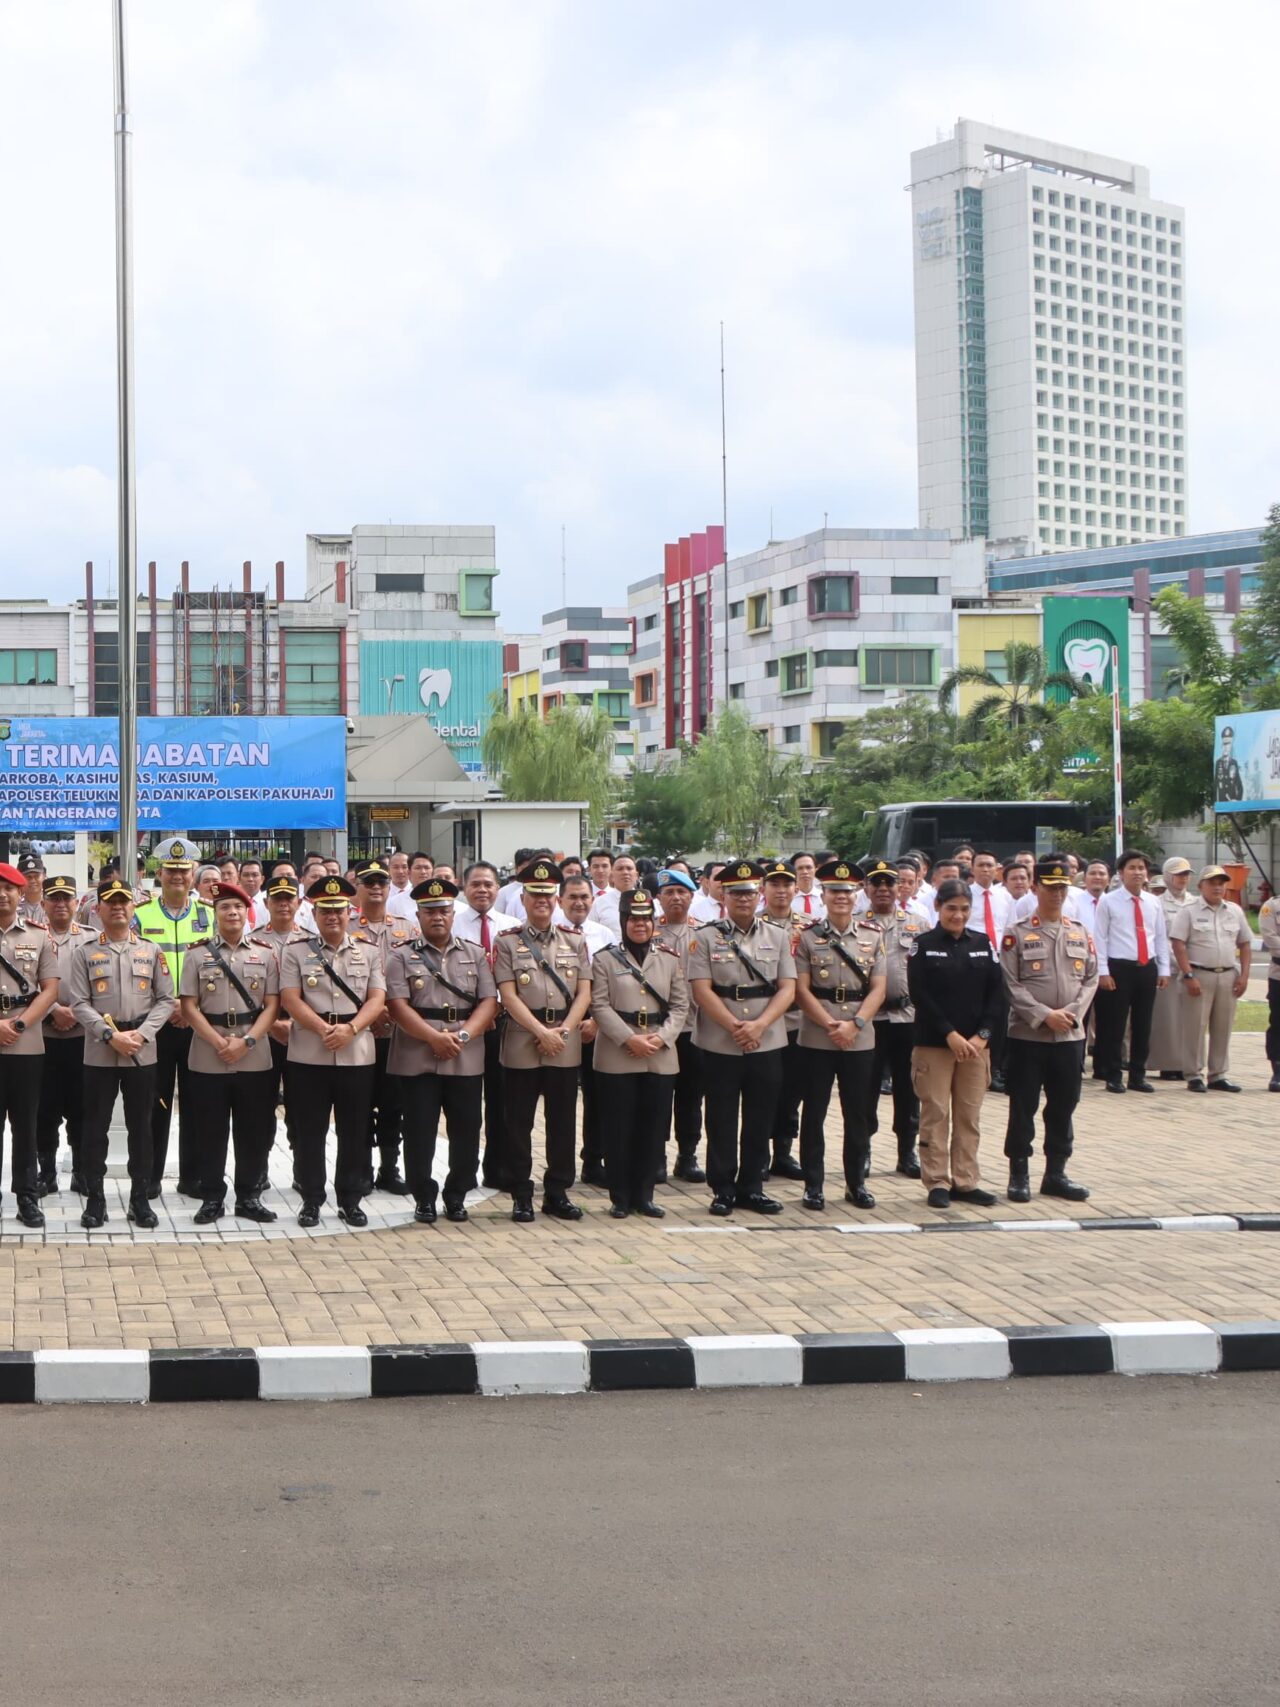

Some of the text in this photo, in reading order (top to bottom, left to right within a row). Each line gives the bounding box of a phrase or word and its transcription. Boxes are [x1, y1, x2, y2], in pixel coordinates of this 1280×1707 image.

[433, 720, 480, 737] dental
[6, 744, 120, 768] TERIMA
[66, 772, 155, 786] KASIHUAS,
[158, 772, 218, 786] KASIUM,
[63, 790, 107, 802] TELUK
[153, 789, 183, 801] DAN
[187, 789, 259, 801] KAPOLSEK
[262, 788, 333, 801] PAKUHAJI
[28, 806, 117, 820] TANGERANG
